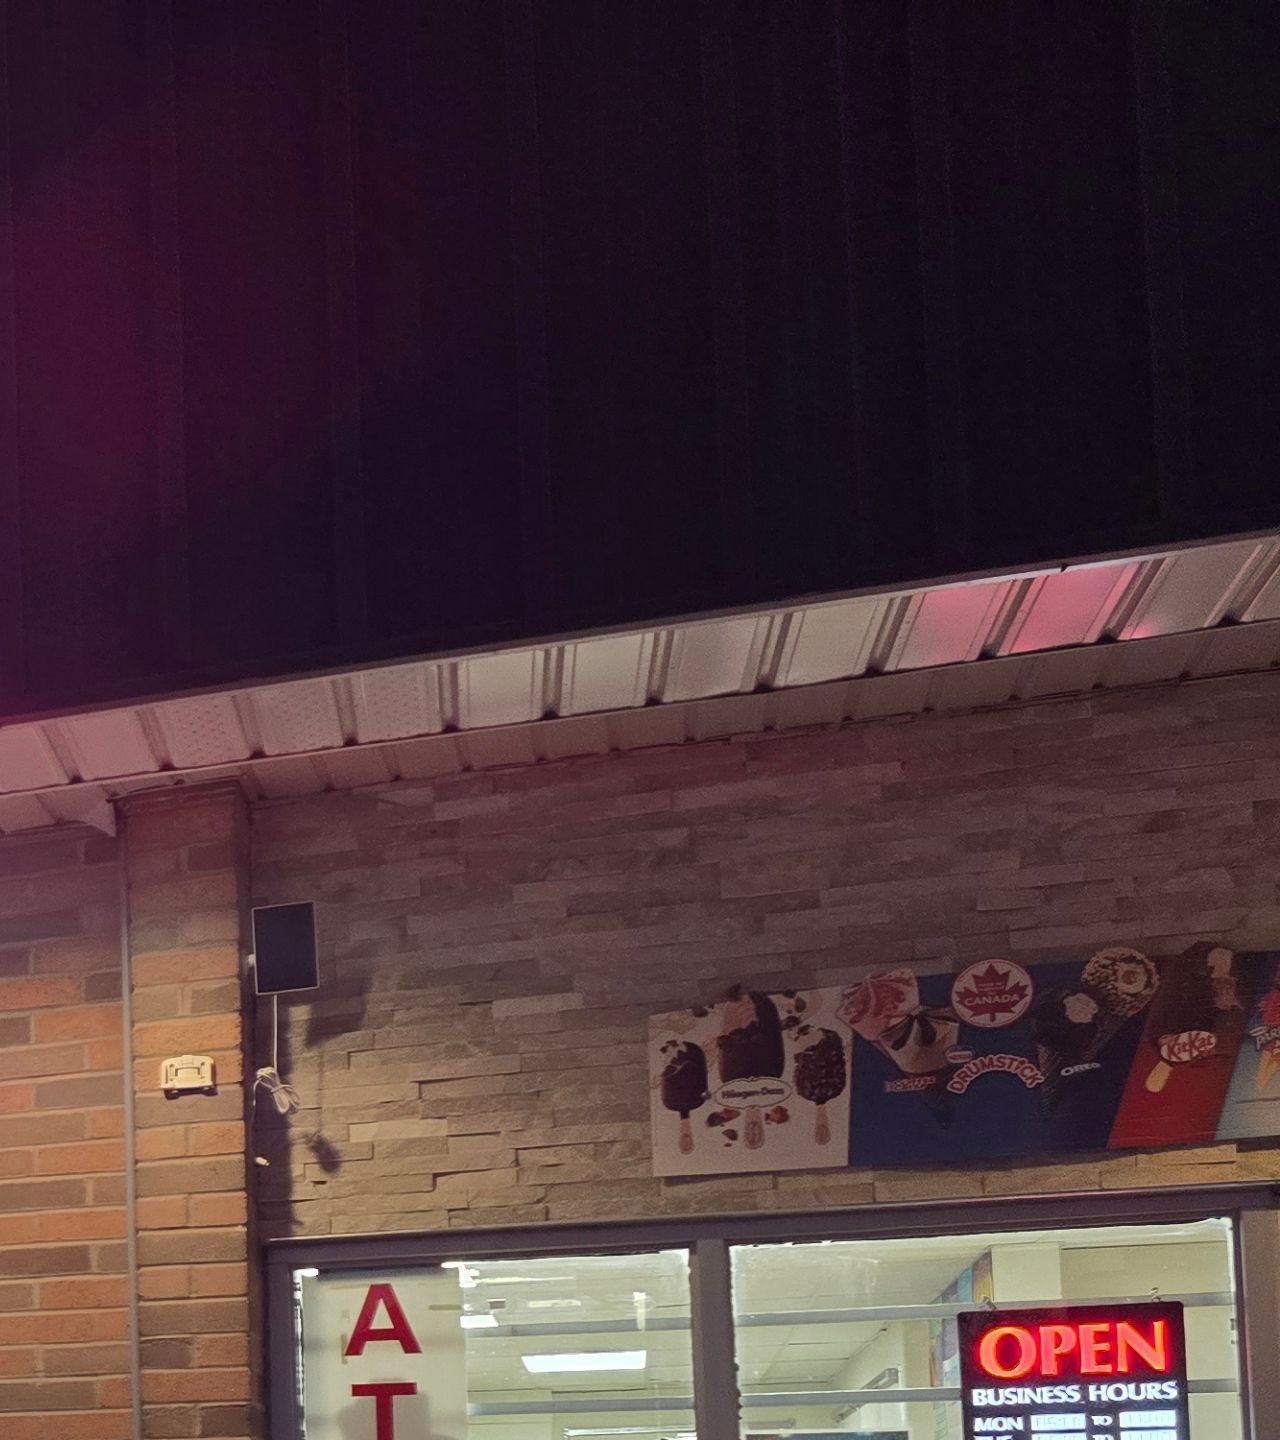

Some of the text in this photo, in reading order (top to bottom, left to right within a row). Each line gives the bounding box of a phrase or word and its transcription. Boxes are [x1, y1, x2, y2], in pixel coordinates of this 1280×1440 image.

[964, 993, 1021, 1006] CANADA
[948, 1054, 1045, 1094] DRUMSTICK
[979, 1320, 1167, 1379] OPEN
[971, 1380, 1179, 1407] BUSINESS HOURS
[973, 1416, 1024, 1432] MON
